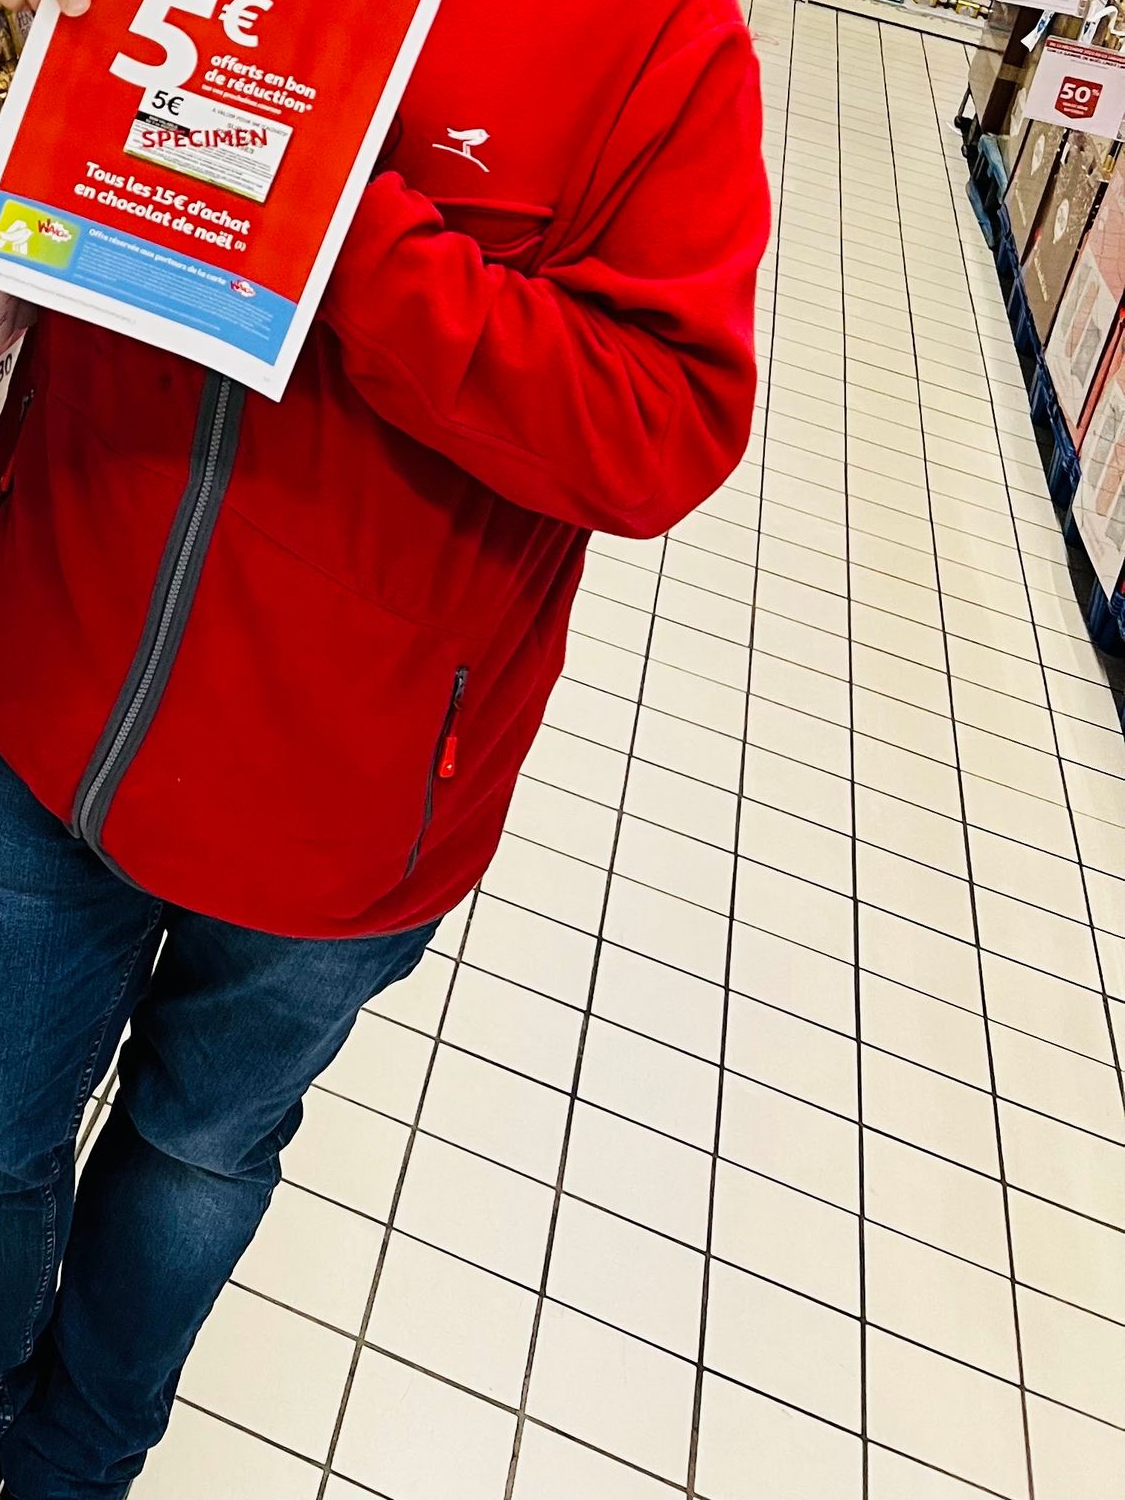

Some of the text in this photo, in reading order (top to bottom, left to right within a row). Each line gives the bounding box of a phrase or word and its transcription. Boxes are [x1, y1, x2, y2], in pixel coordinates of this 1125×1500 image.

[204, 68, 227, 86] de
[210, 54, 264, 82] offerts
[264, 69, 285, 88] en
[285, 76, 317, 100] bon
[151, 90, 185, 116] 5€
[141, 127, 268, 148] SPECIMEN
[86, 161, 251, 235] Tous les 15€ d'achat
[74, 183, 97, 200] en
[96, 190, 172, 227] chocolat
[171, 216, 195, 236] de
[193, 226, 233, 251] noël
